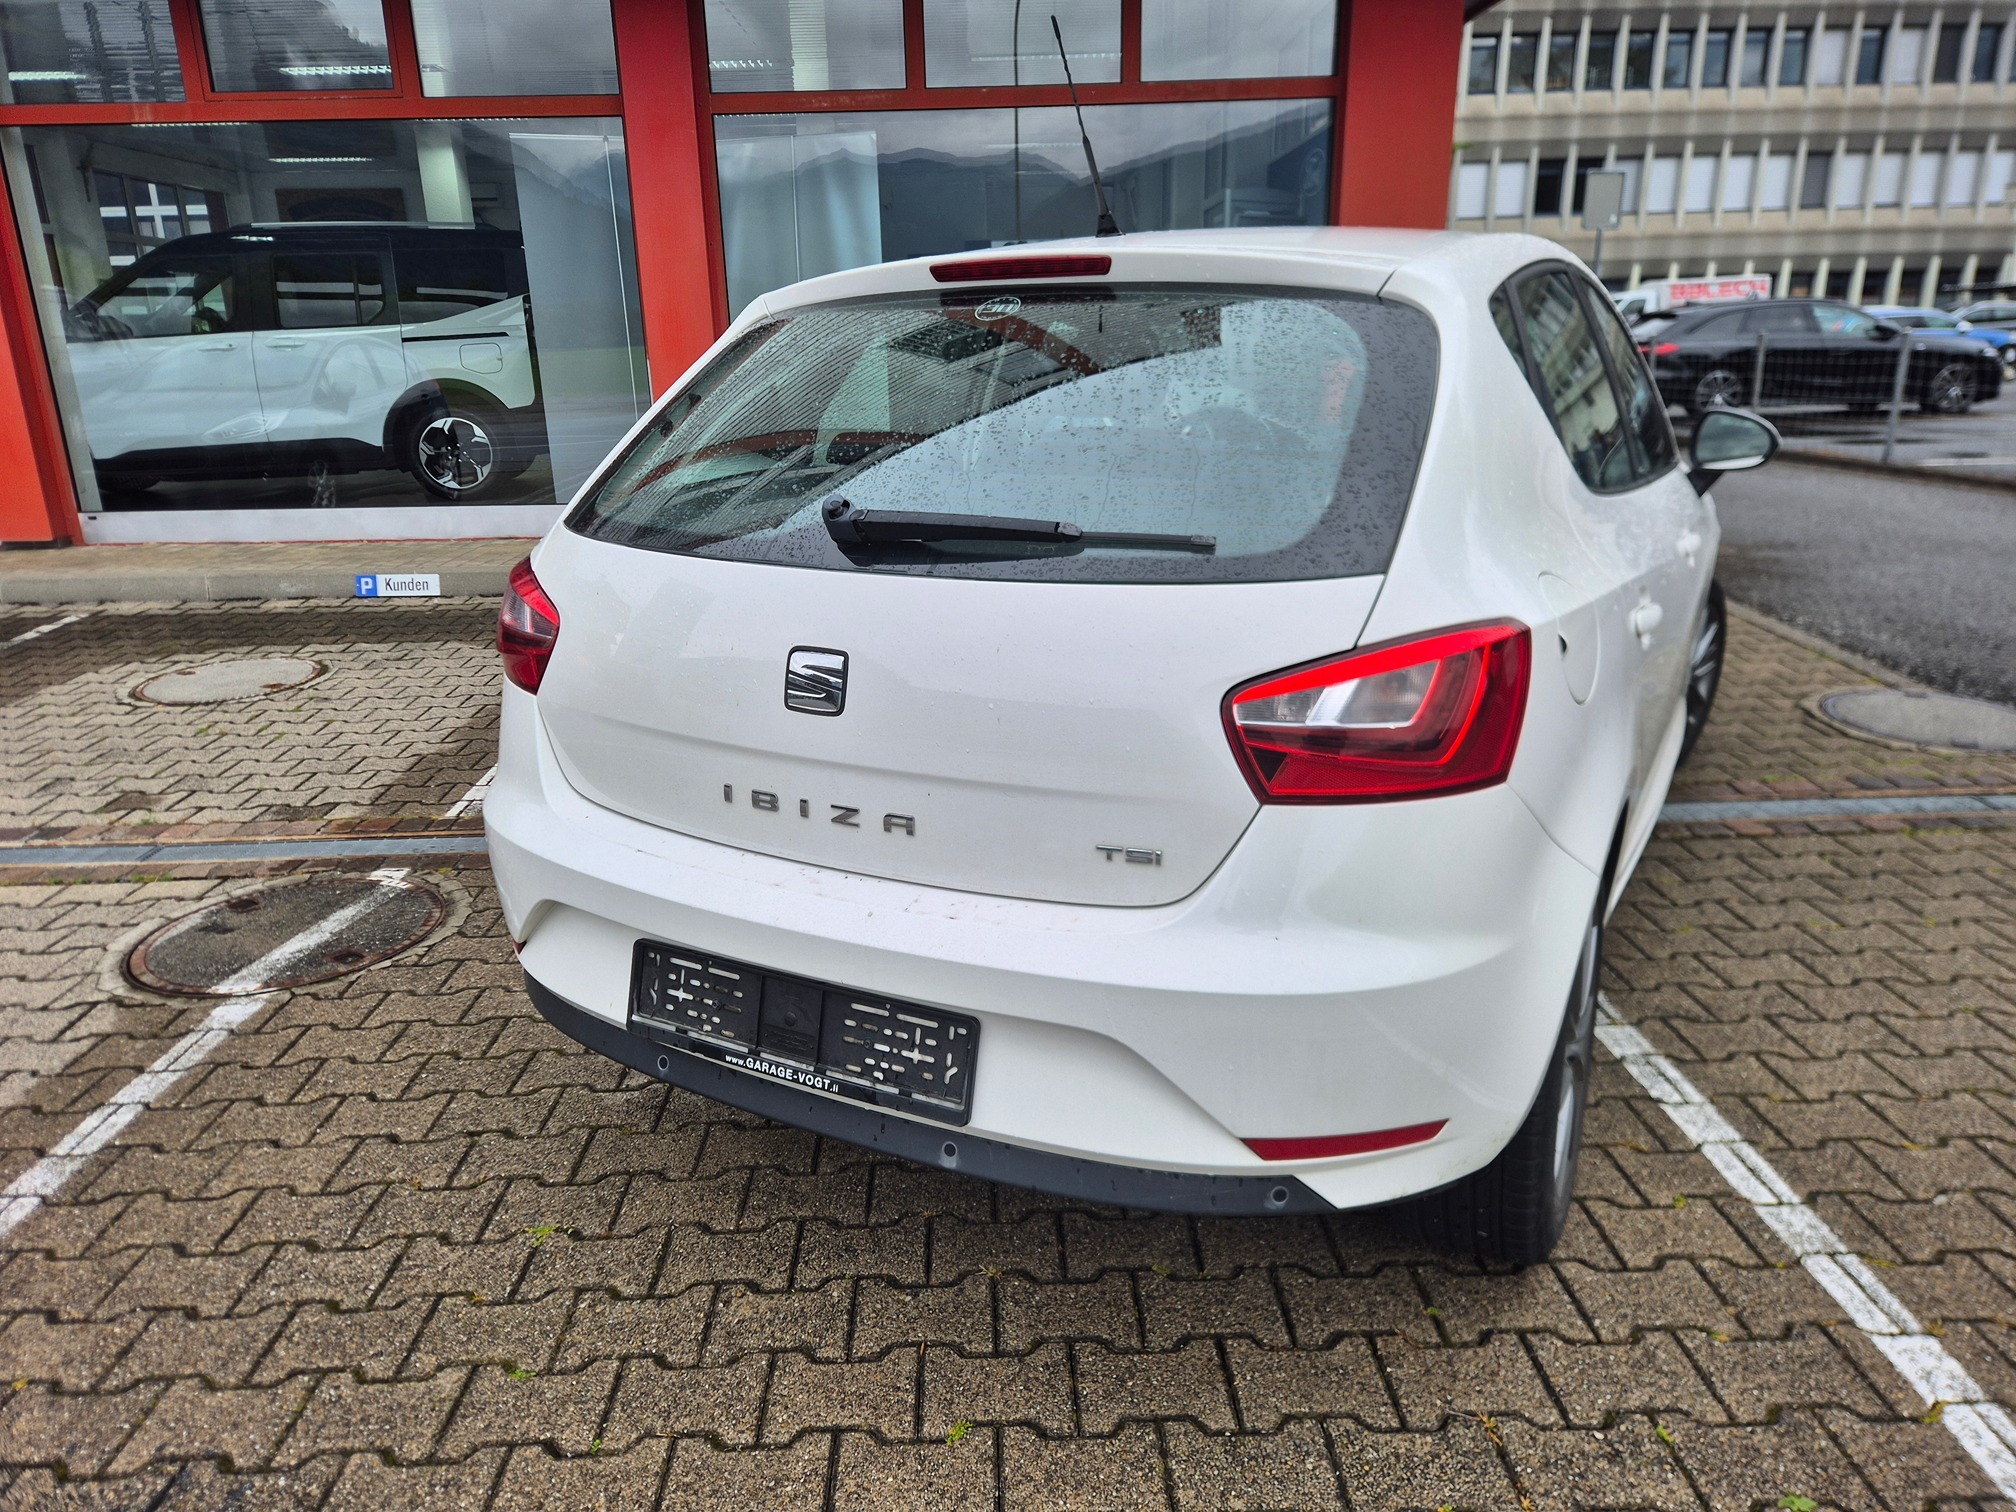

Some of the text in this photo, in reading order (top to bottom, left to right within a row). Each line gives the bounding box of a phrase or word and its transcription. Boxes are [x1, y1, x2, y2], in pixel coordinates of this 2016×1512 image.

[360, 577, 429, 595] P Kunden
[723, 783, 915, 836] IBIZA
